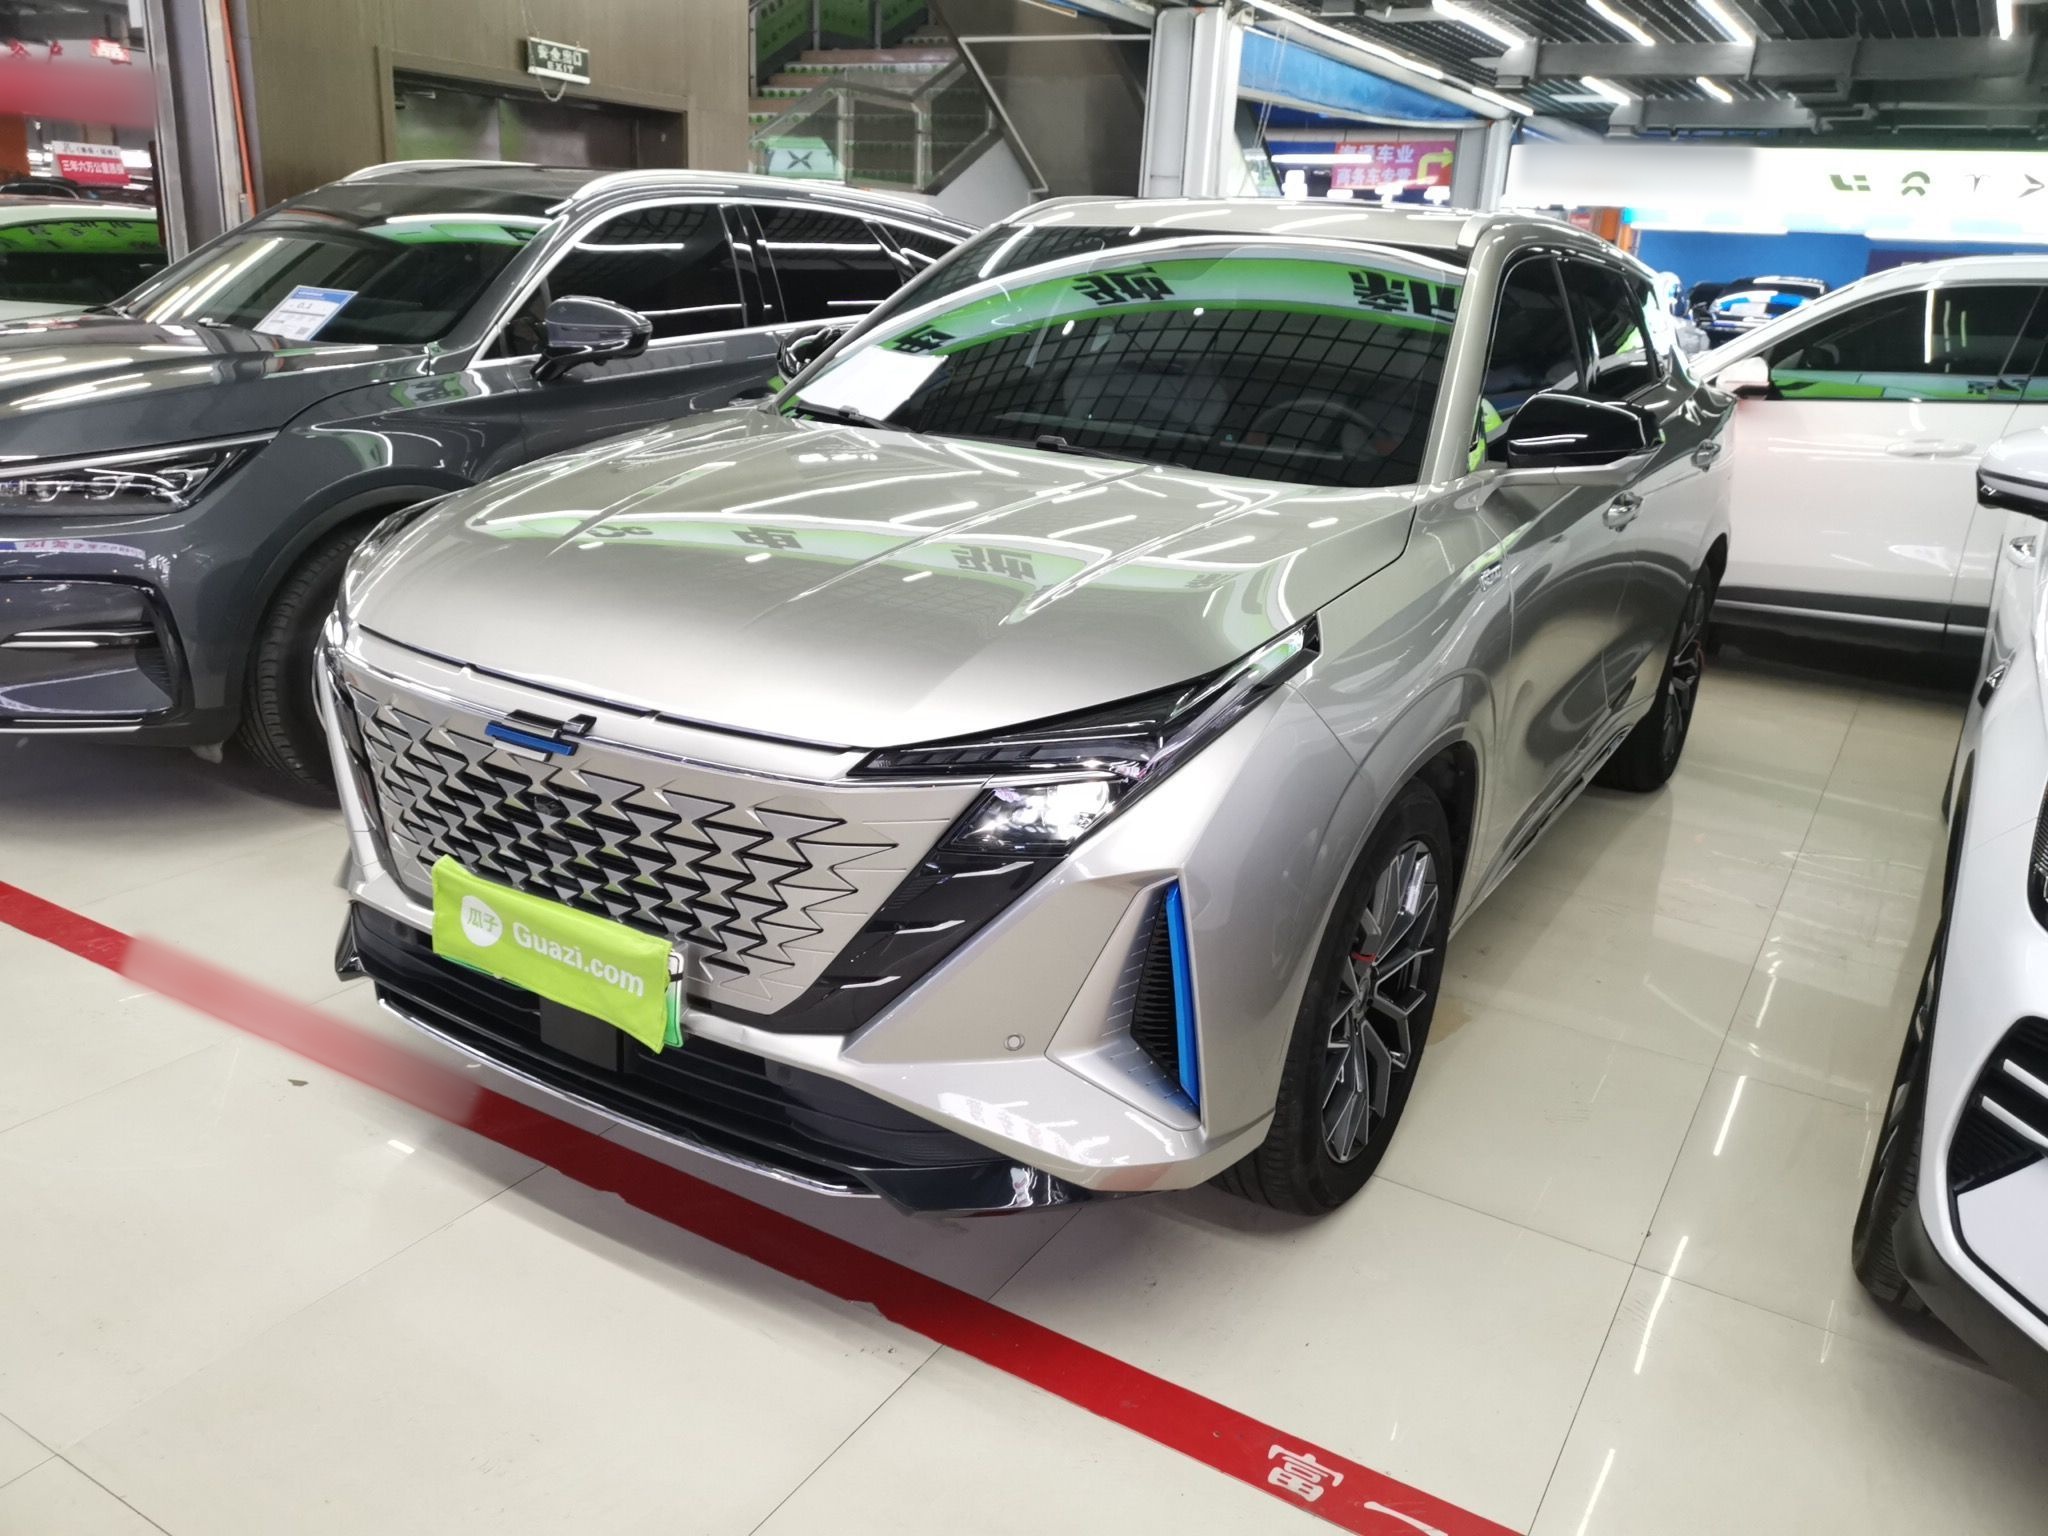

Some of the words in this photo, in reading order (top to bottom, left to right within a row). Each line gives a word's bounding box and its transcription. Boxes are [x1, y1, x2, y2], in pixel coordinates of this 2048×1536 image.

[537, 45, 582, 66] 安全出口
[547, 61, 574, 74] EXIT
[467, 907, 499, 933] 瓜子
[512, 921, 645, 997] Guazi.com
